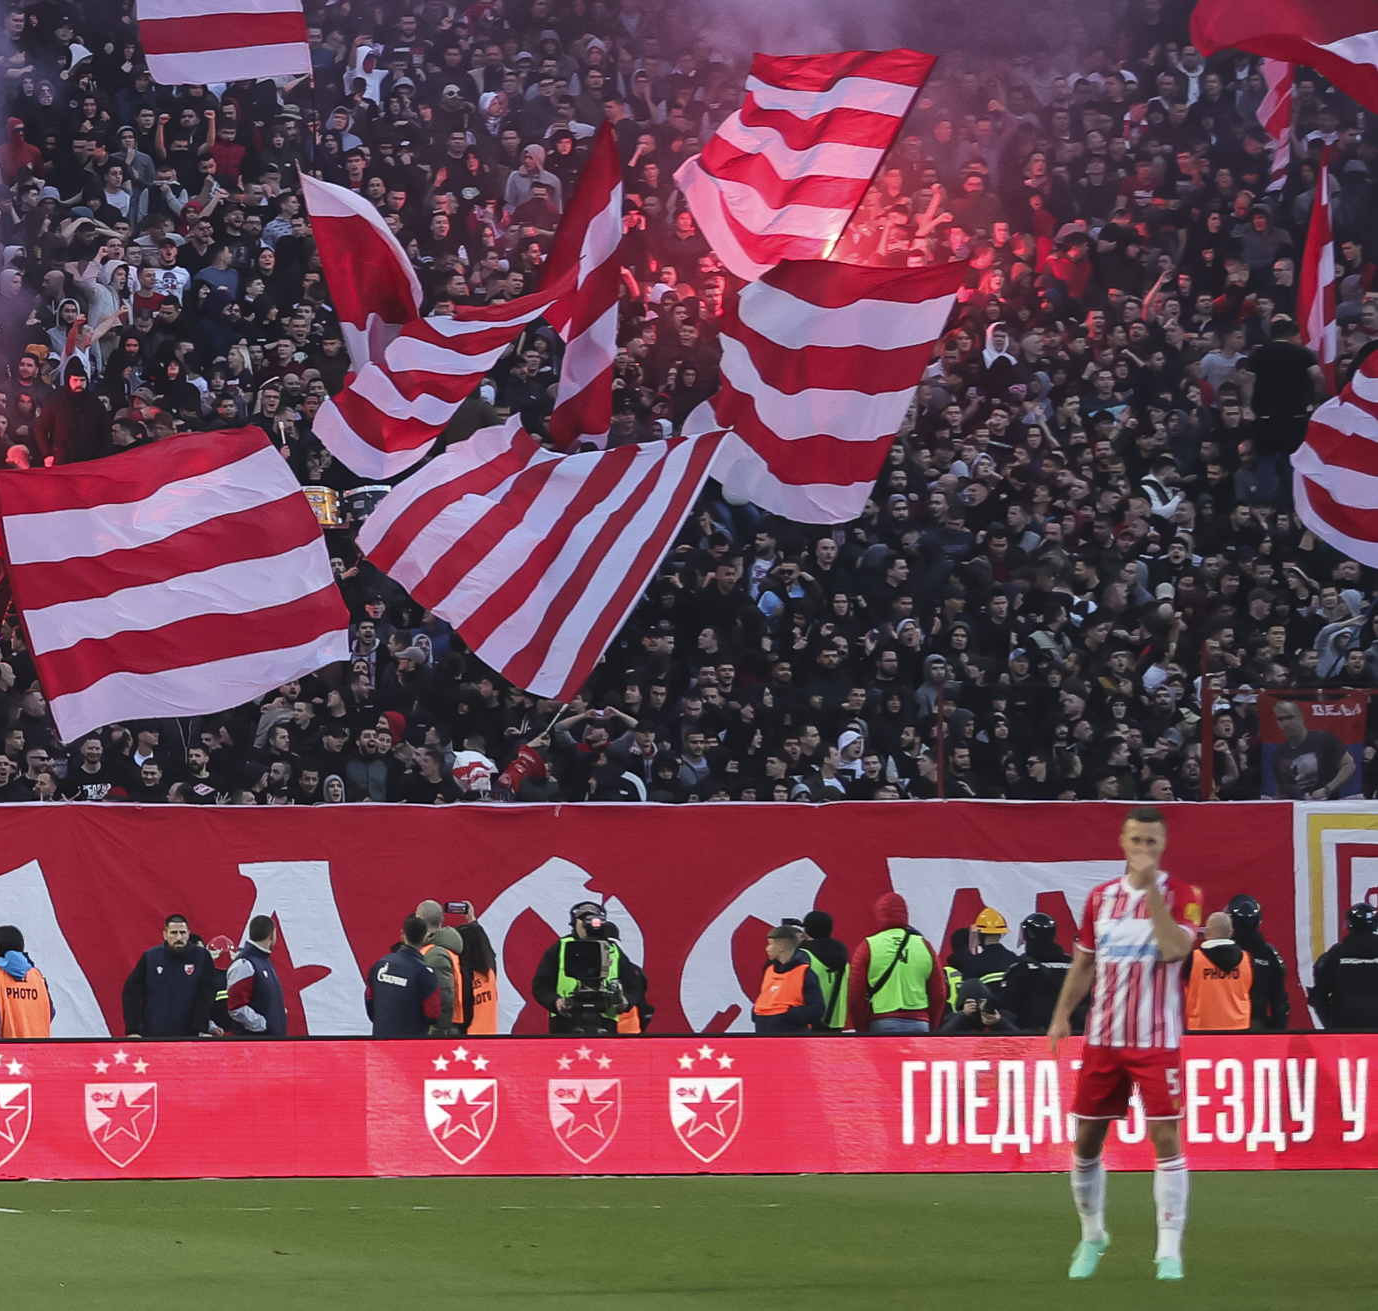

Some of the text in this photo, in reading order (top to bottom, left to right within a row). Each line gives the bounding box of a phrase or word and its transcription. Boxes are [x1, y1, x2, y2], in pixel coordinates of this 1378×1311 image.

[6, 987, 38, 1000] PHOTO
[1165, 1068, 1180, 1096] 5
[1340, 1058, 1368, 1143] У
